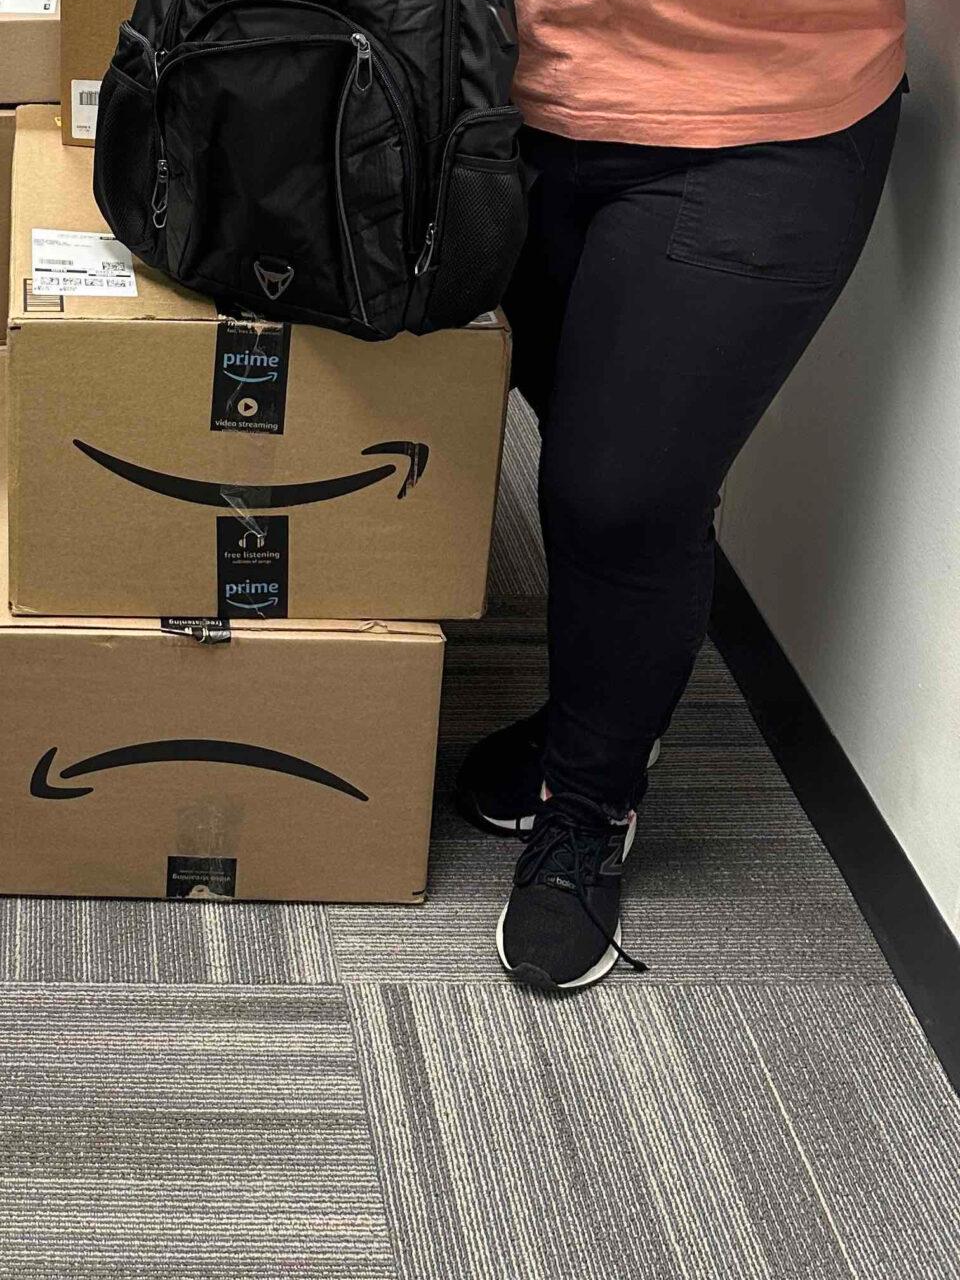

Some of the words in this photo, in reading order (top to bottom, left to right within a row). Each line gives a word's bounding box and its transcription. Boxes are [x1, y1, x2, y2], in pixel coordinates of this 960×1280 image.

[223, 350, 279, 368] prime
[215, 419, 237, 428] video
[239, 421, 279, 431] streaming
[224, 551, 241, 559] free
[243, 551, 280, 559] listening
[225, 579, 279, 598] prime
